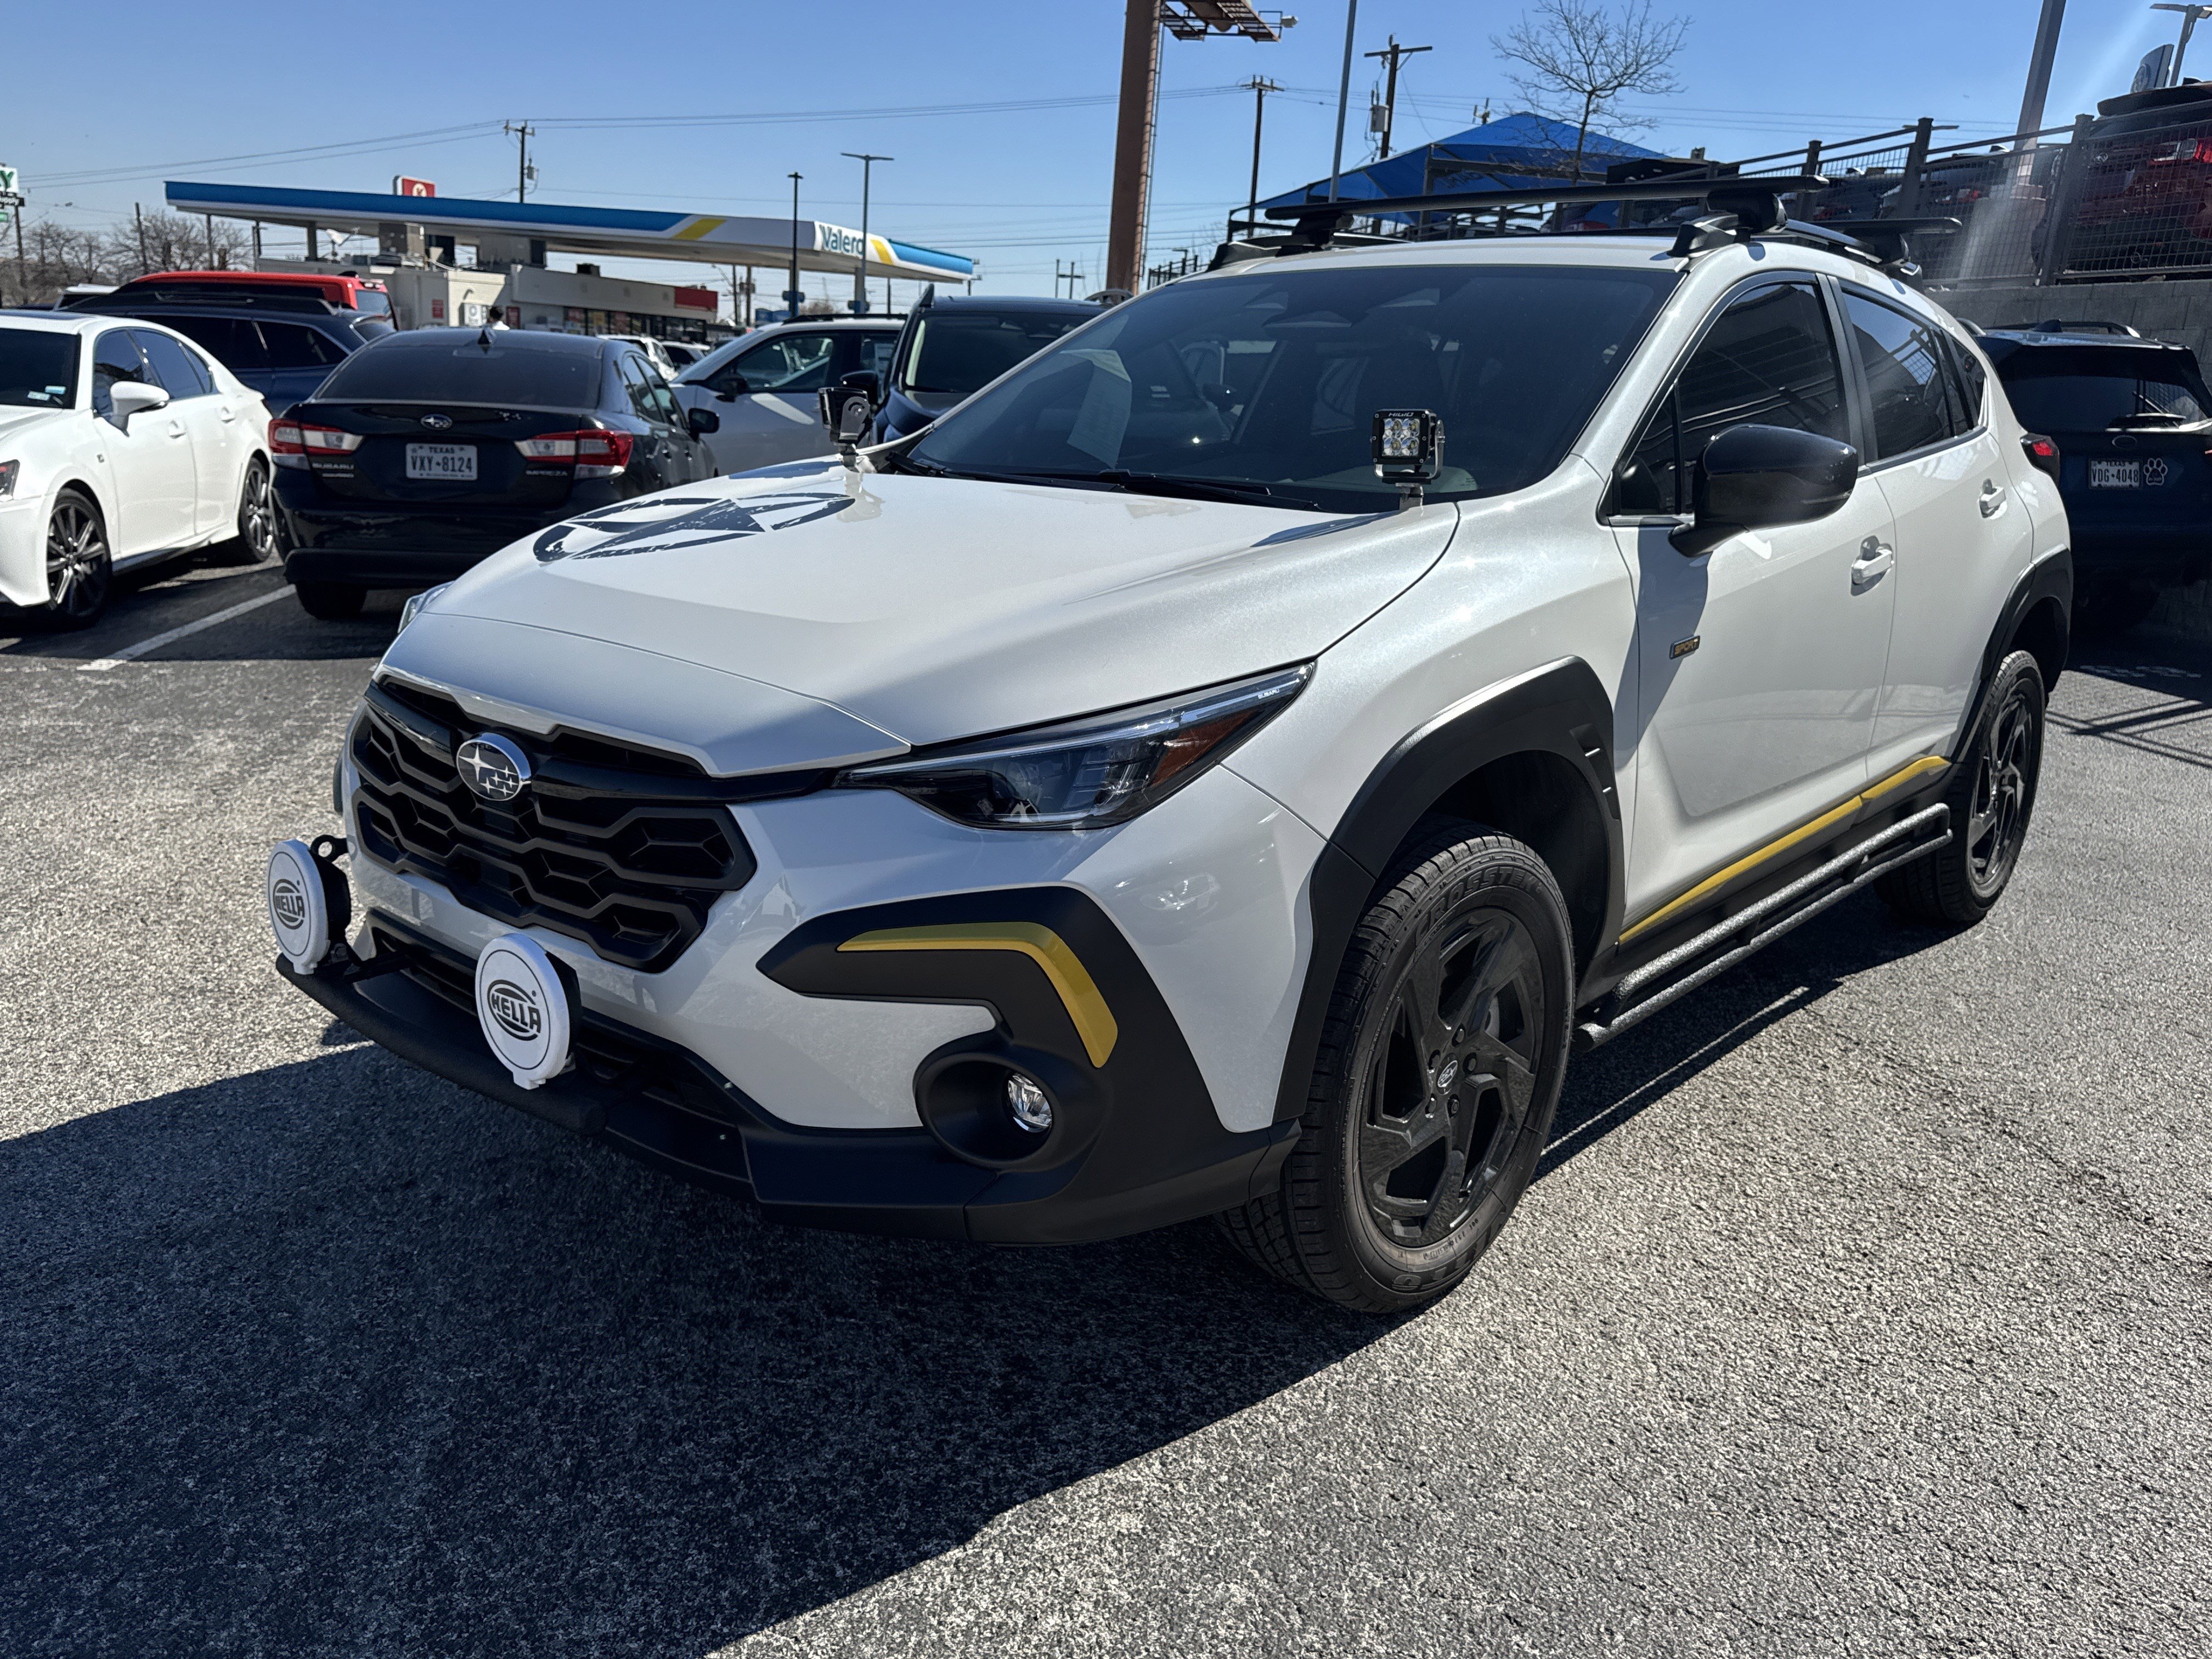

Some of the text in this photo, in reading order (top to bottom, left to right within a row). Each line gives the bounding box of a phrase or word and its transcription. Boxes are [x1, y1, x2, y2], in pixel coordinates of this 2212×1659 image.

[442, 456, 472, 473] 8124
[2115, 468, 2138, 483] 4048
[1674, 637, 1699, 655] SPORT
[1257, 689, 1280, 699] SUBARU
[275, 895, 305, 918] HELLA
[491, 993, 541, 1034] HELLA
